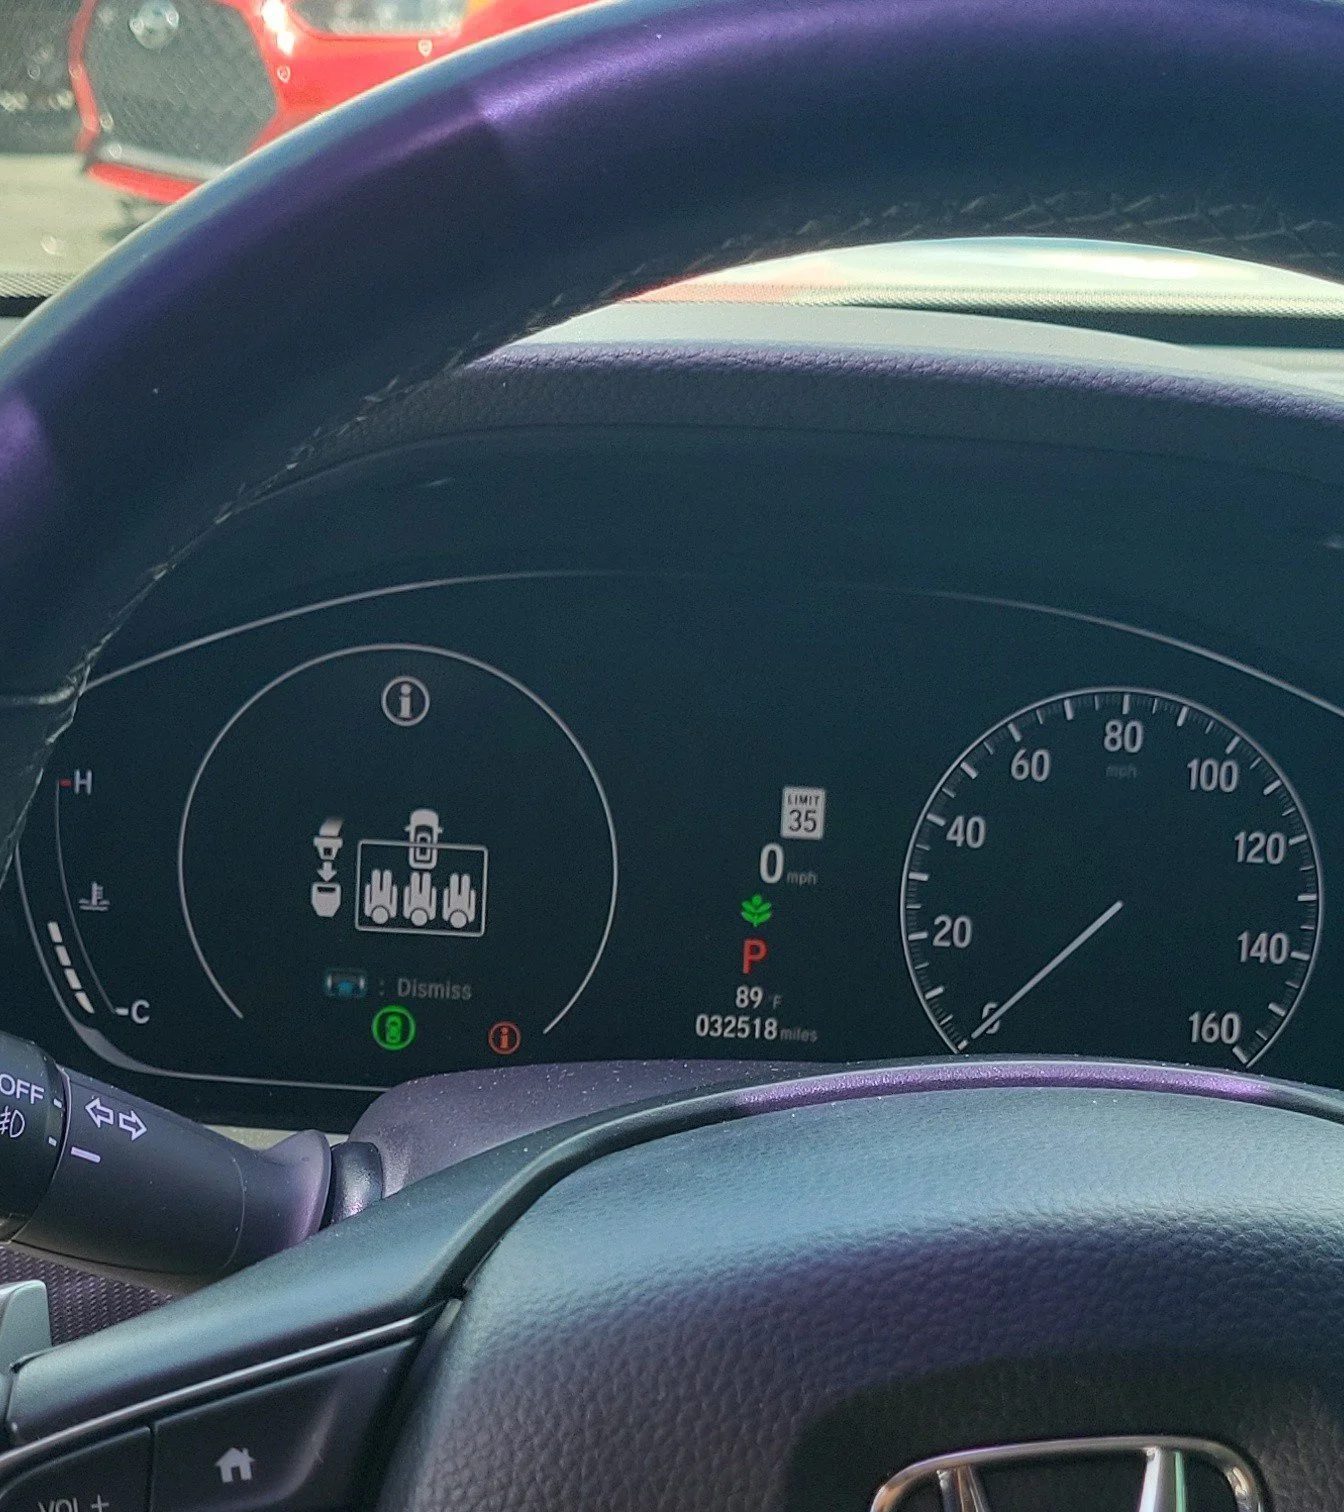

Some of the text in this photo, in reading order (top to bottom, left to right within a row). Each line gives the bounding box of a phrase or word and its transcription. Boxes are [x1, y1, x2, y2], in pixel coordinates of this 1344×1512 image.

[1103, 720, 1144, 753] 80
[73, 769, 93, 795] H
[1011, 749, 1050, 782] 60
[1187, 759, 1239, 793] 100
[787, 794, 820, 806] LIMIT
[788, 808, 817, 833] 35
[946, 816, 986, 849] 40
[1233, 831, 1286, 864] 120
[759, 843, 817, 886] 0 mph
[933, 915, 973, 949] 20
[1237, 931, 1289, 964] 140
[743, 938, 768, 974] P
[397, 978, 472, 1001] Dismiss
[735, 986, 763, 1009] 89
[131, 1000, 151, 1026] C
[695, 1014, 818, 1043] 032518 miles
[1188, 1010, 1241, 1045] 160
